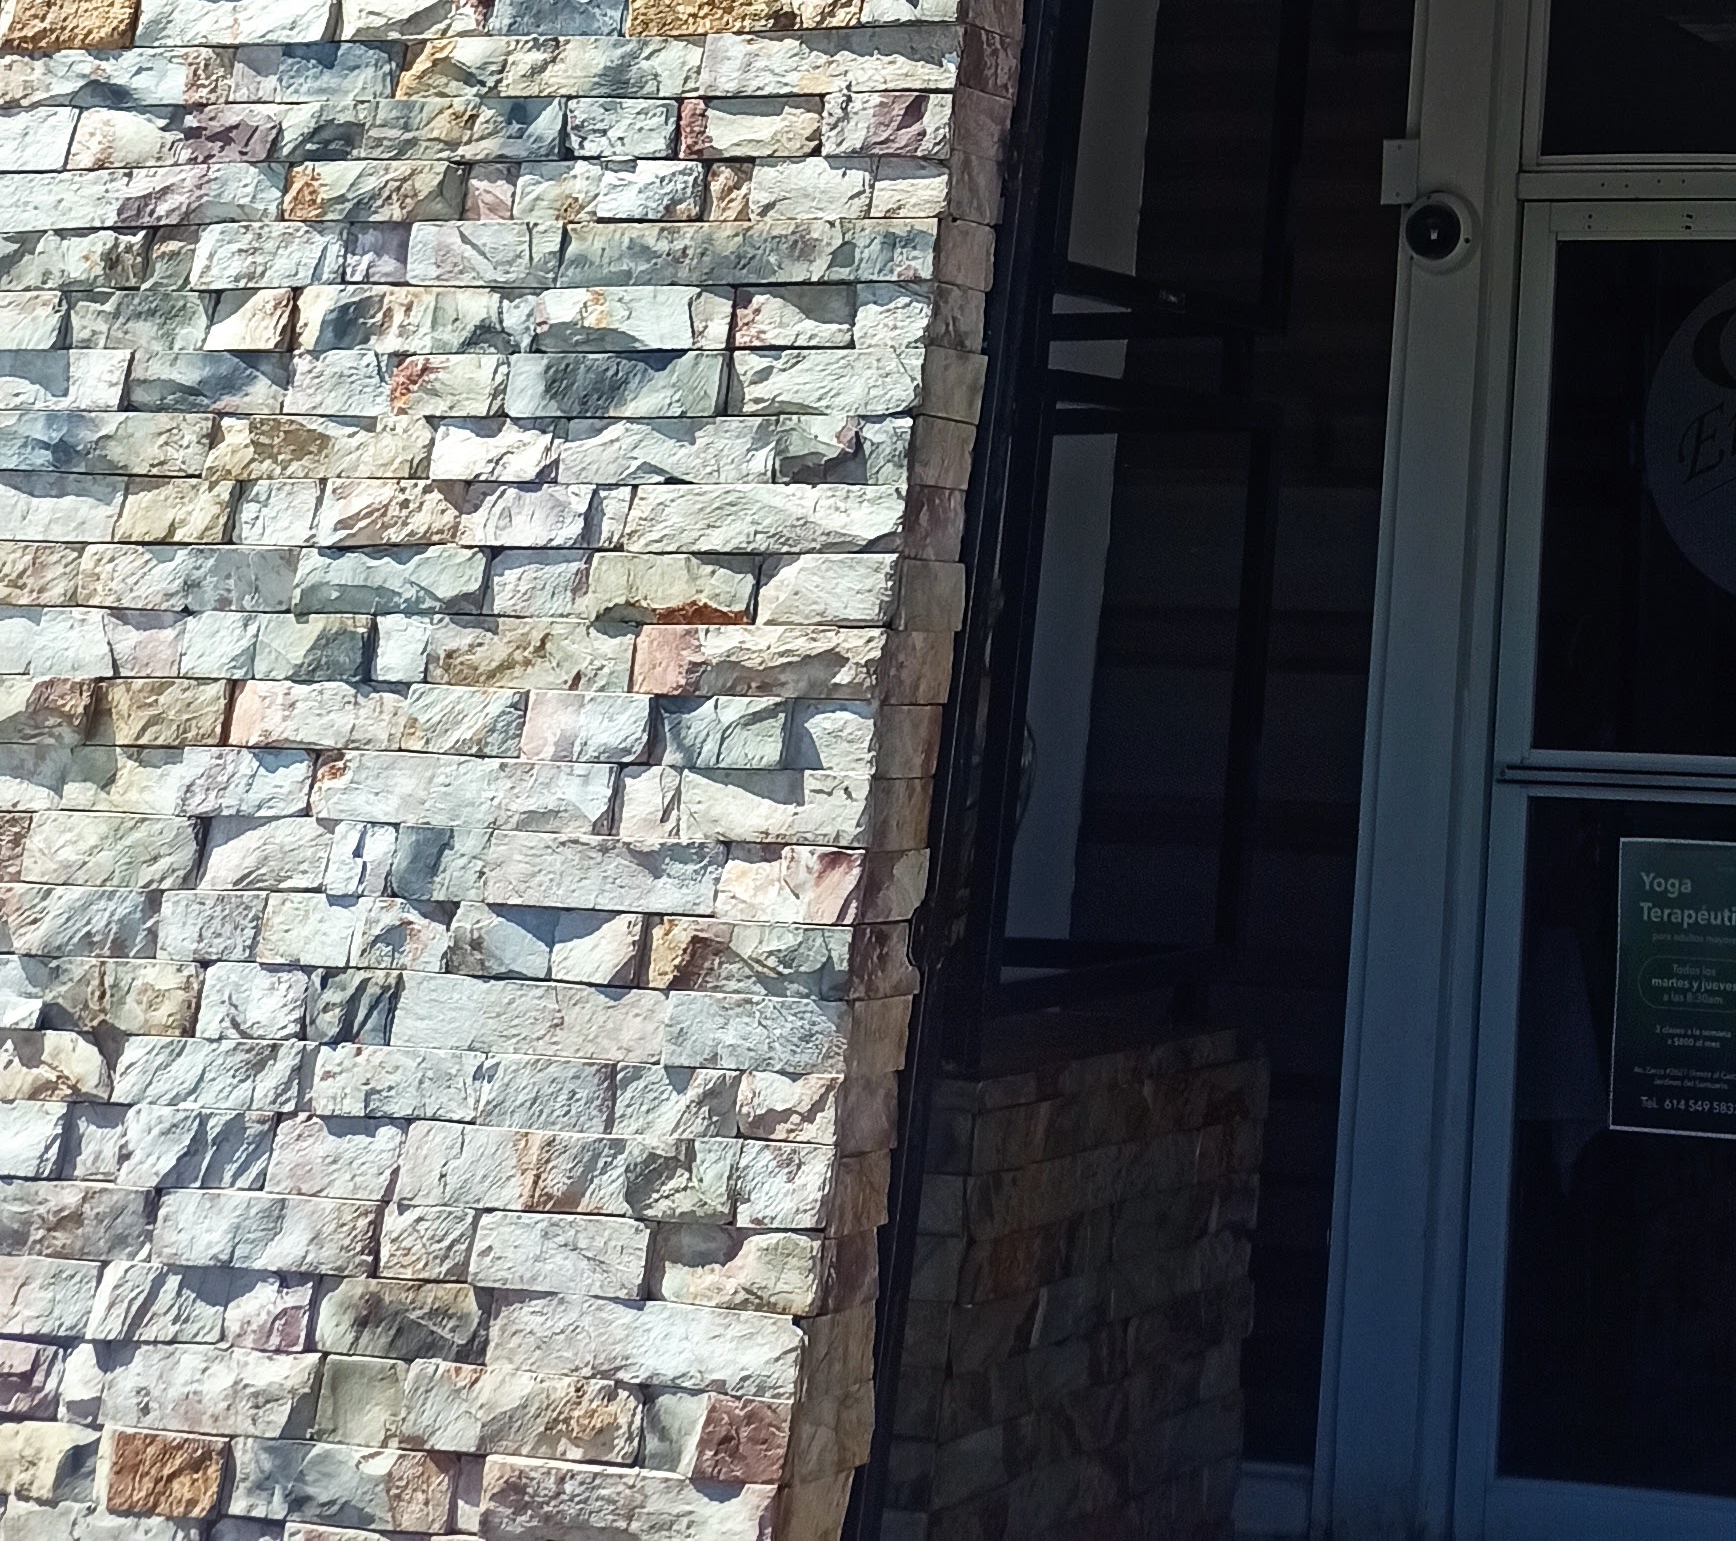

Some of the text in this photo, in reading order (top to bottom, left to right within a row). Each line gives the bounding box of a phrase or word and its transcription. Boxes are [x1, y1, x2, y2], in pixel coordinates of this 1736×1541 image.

[1640, 872, 1692, 899] Yoga
[1652, 933, 1672, 943] para
[1673, 933, 1704, 943] adultos
[1672, 963, 1717, 977] Todos los
[1651, 977, 1690, 989] martes
[1691, 981, 1699, 993] y
[1671, 990, 1685, 1003] las
[1664, 1098, 1686, 1110] 614
[1688, 1099, 1711, 1112] 549
